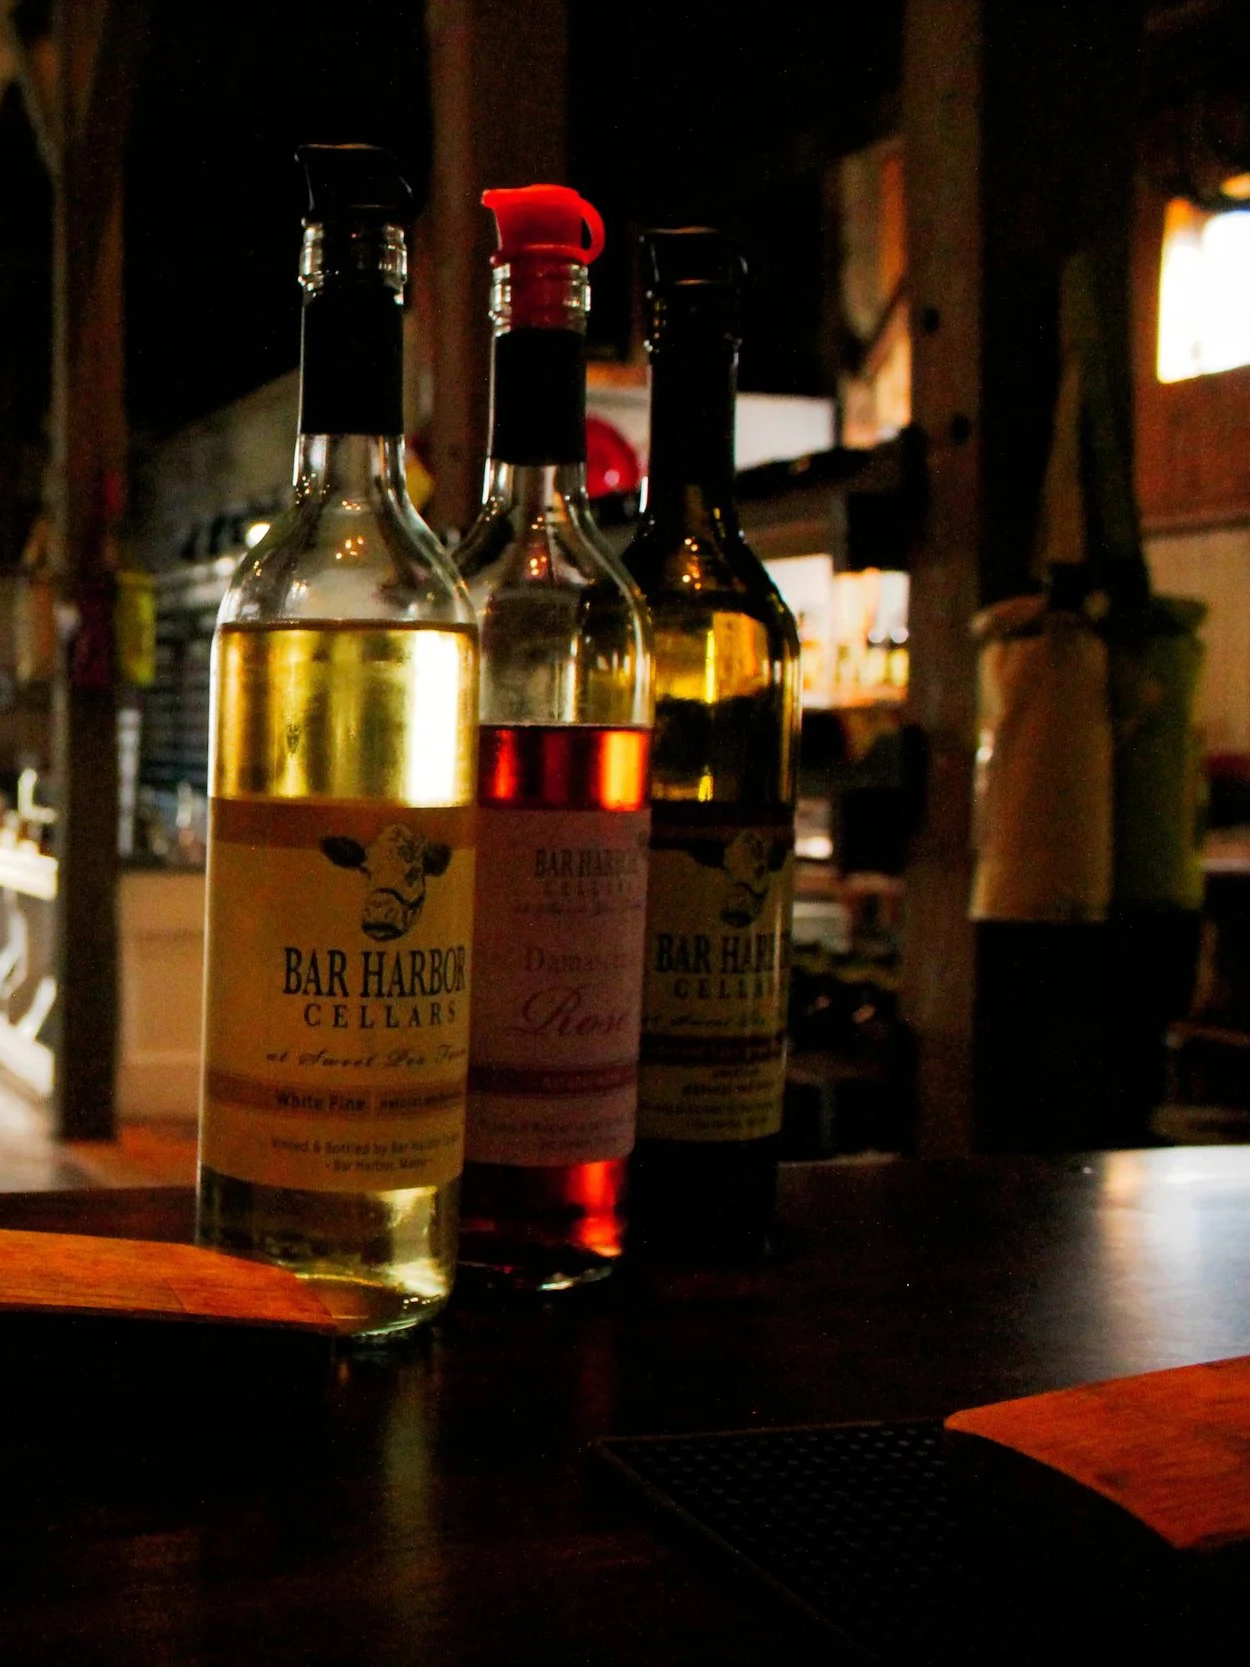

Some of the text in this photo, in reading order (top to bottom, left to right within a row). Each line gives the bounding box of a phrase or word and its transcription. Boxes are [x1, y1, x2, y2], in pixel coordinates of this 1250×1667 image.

[655, 932, 711, 974] BAR
[282, 945, 466, 998] BAR HARBOR
[303, 1003, 456, 1029] CELLARS
[276, 1090, 324, 1111] White
[328, 1093, 367, 1112] Pine
